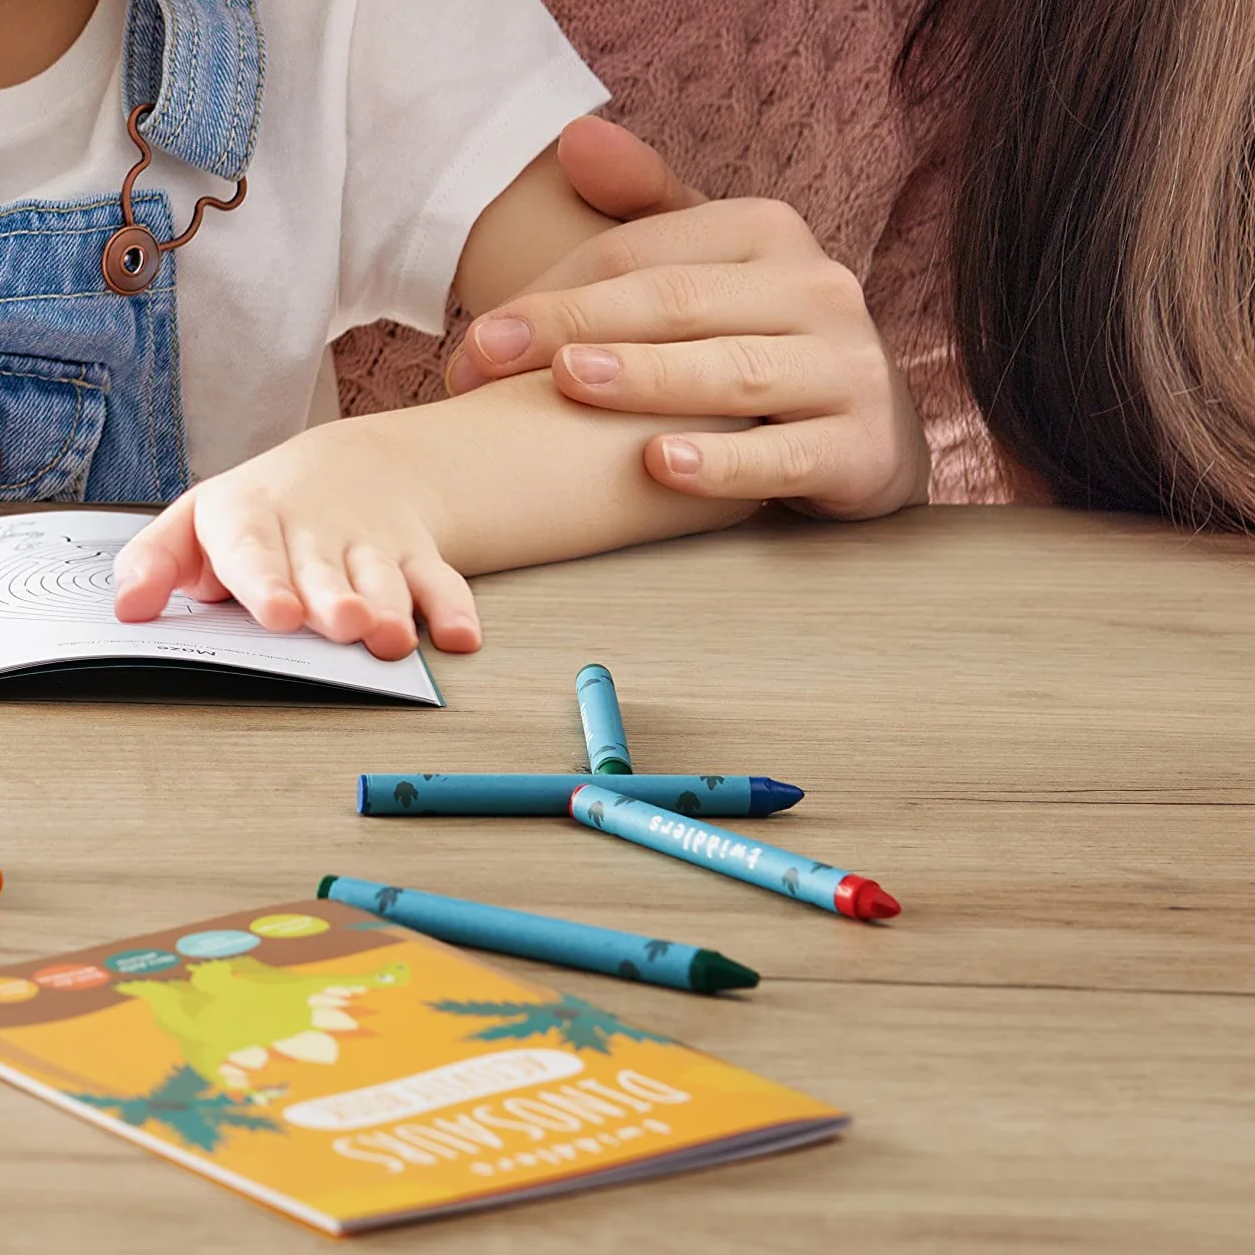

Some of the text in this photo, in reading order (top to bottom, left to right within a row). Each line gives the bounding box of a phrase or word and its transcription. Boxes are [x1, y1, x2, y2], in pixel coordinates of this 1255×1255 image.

[157, 646, 216, 657] Maze
[648, 815, 762, 869] twiddlers
[332, 1068, 692, 1174] DINOSAURS
